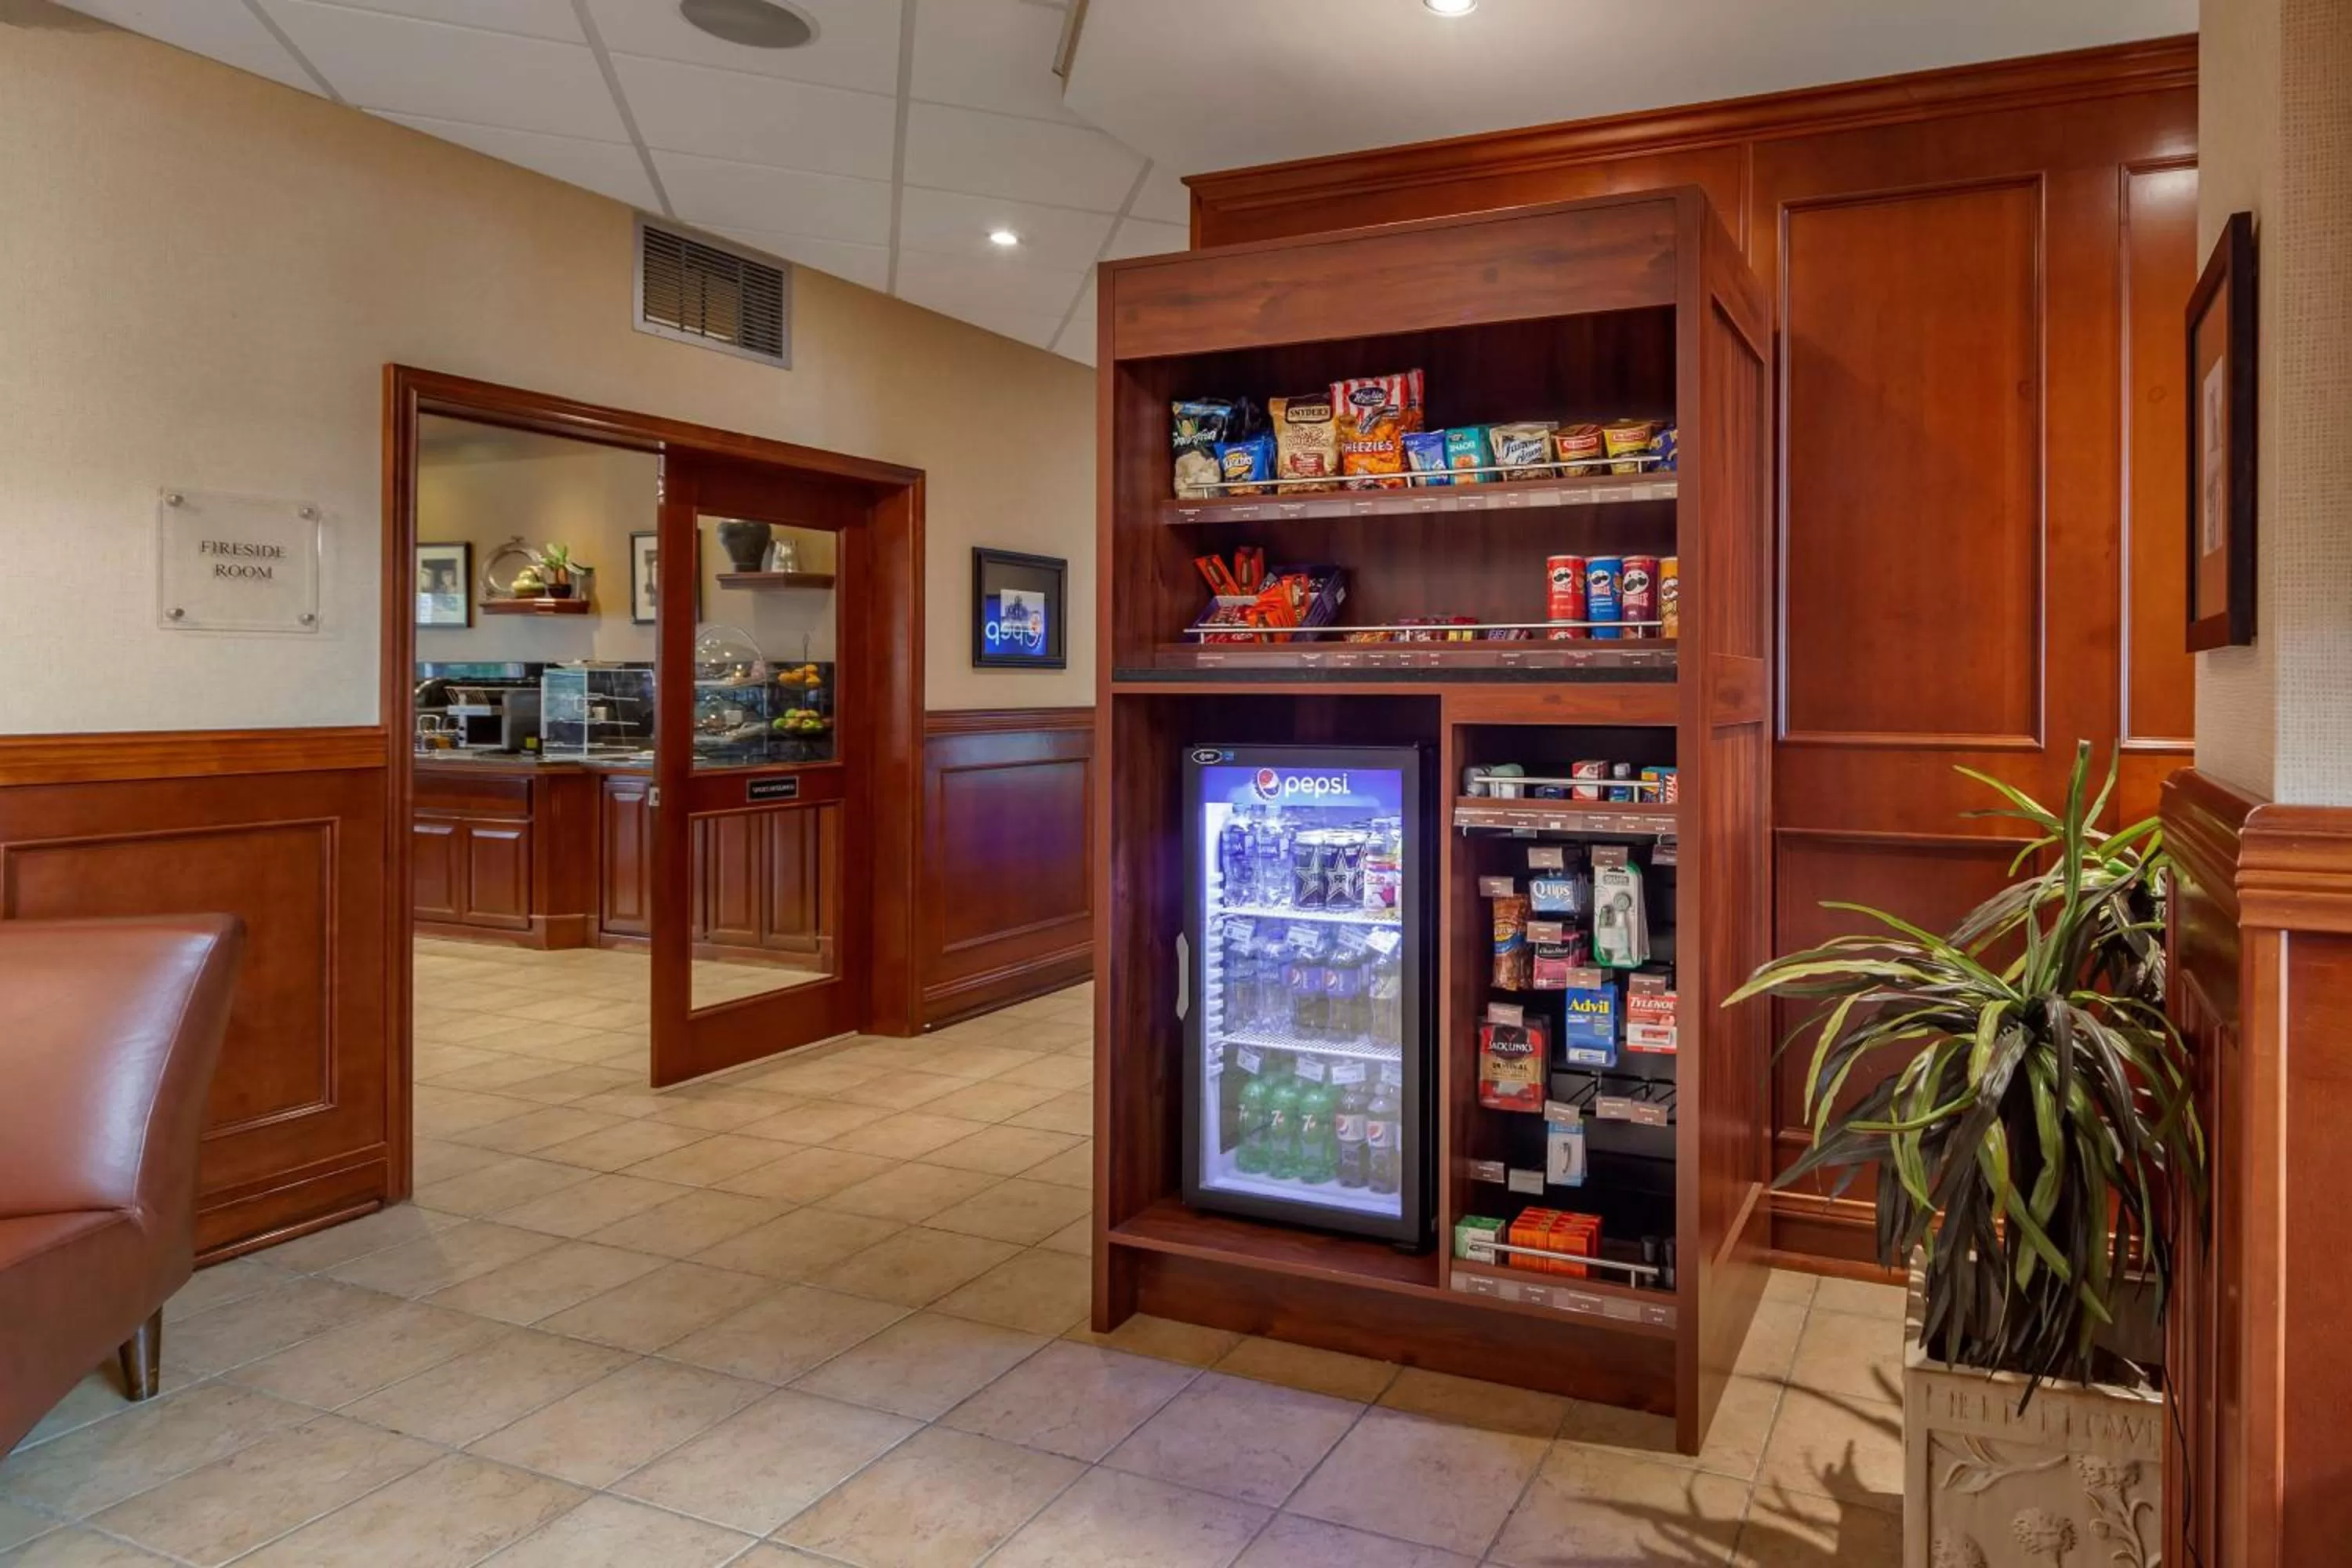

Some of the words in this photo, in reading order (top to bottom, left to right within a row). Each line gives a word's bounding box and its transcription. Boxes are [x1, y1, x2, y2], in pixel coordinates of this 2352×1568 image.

[200, 539, 286, 559] FIRESIDE
[214, 564, 274, 579] ROOM
[1284, 772, 1351, 799] pepsi
[1568, 997, 1610, 1014] Advil
[1630, 996, 1675, 1011] TYLENOL
